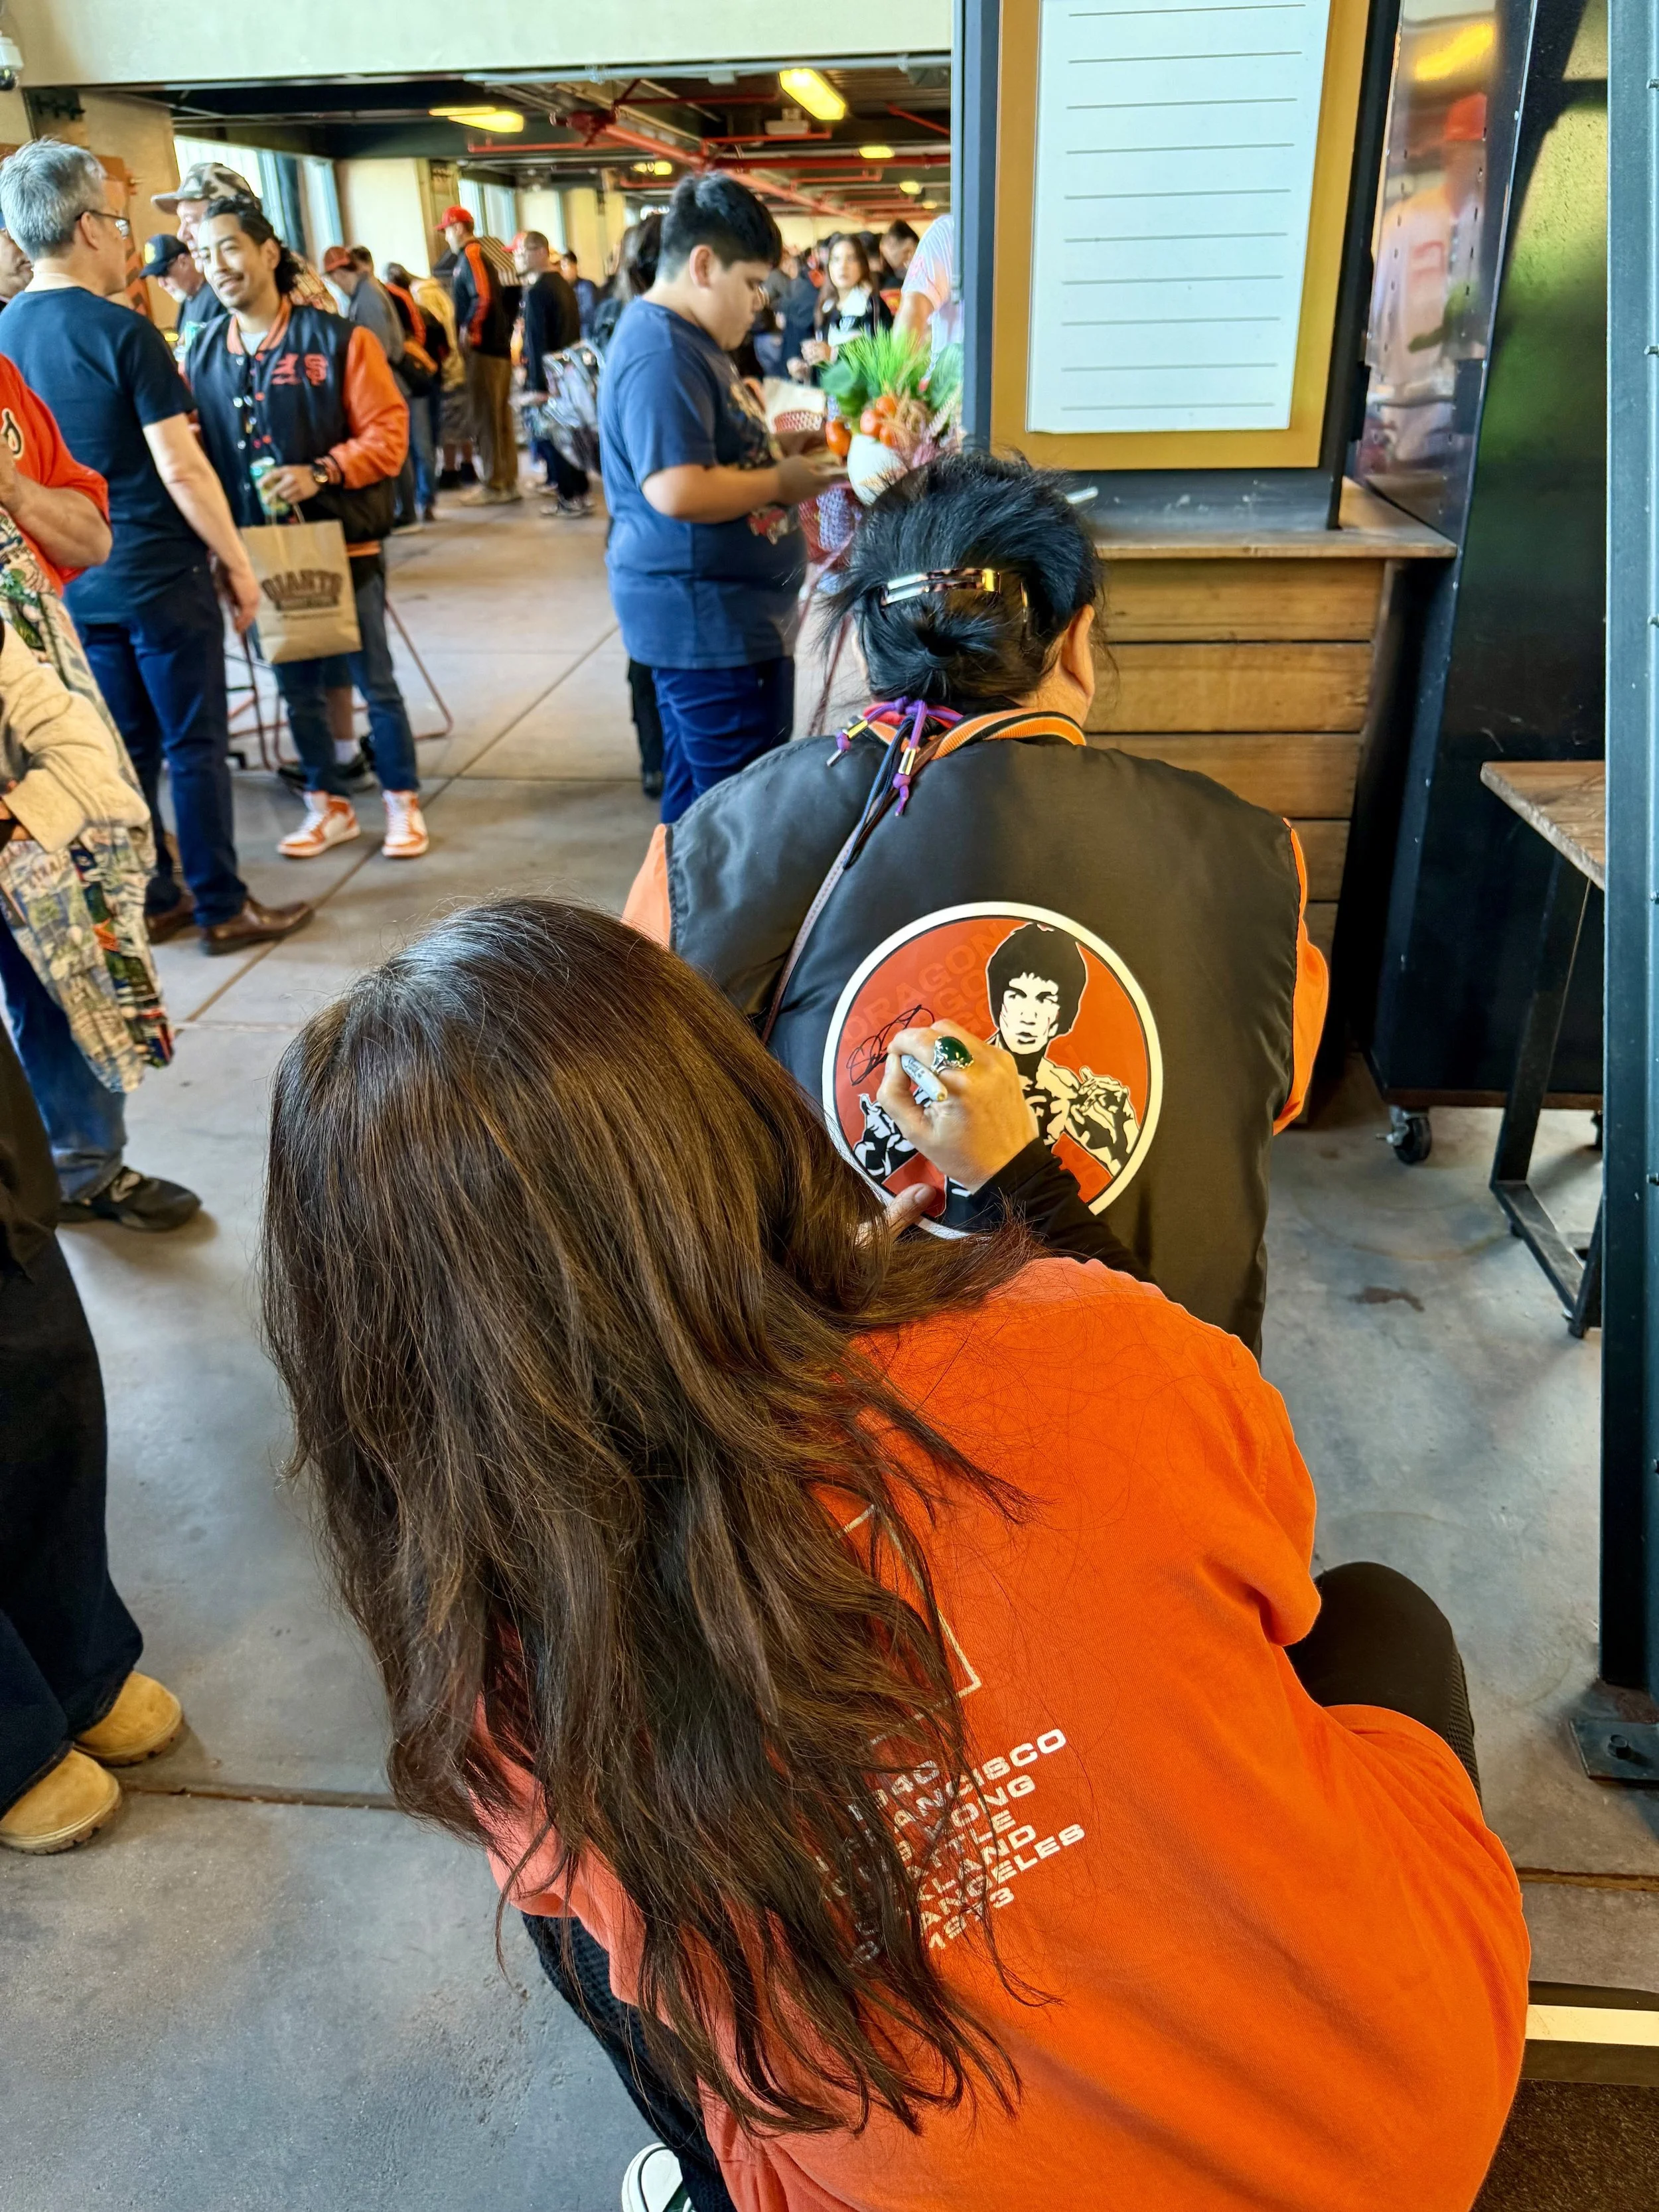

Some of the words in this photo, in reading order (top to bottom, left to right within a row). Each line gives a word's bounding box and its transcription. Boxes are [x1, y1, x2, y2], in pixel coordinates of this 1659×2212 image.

[845, 921, 1005, 1049] DRAGON
[853, 1729, 1067, 1848] ANCISCO
[920, 1824, 1086, 1937] ANGELES
